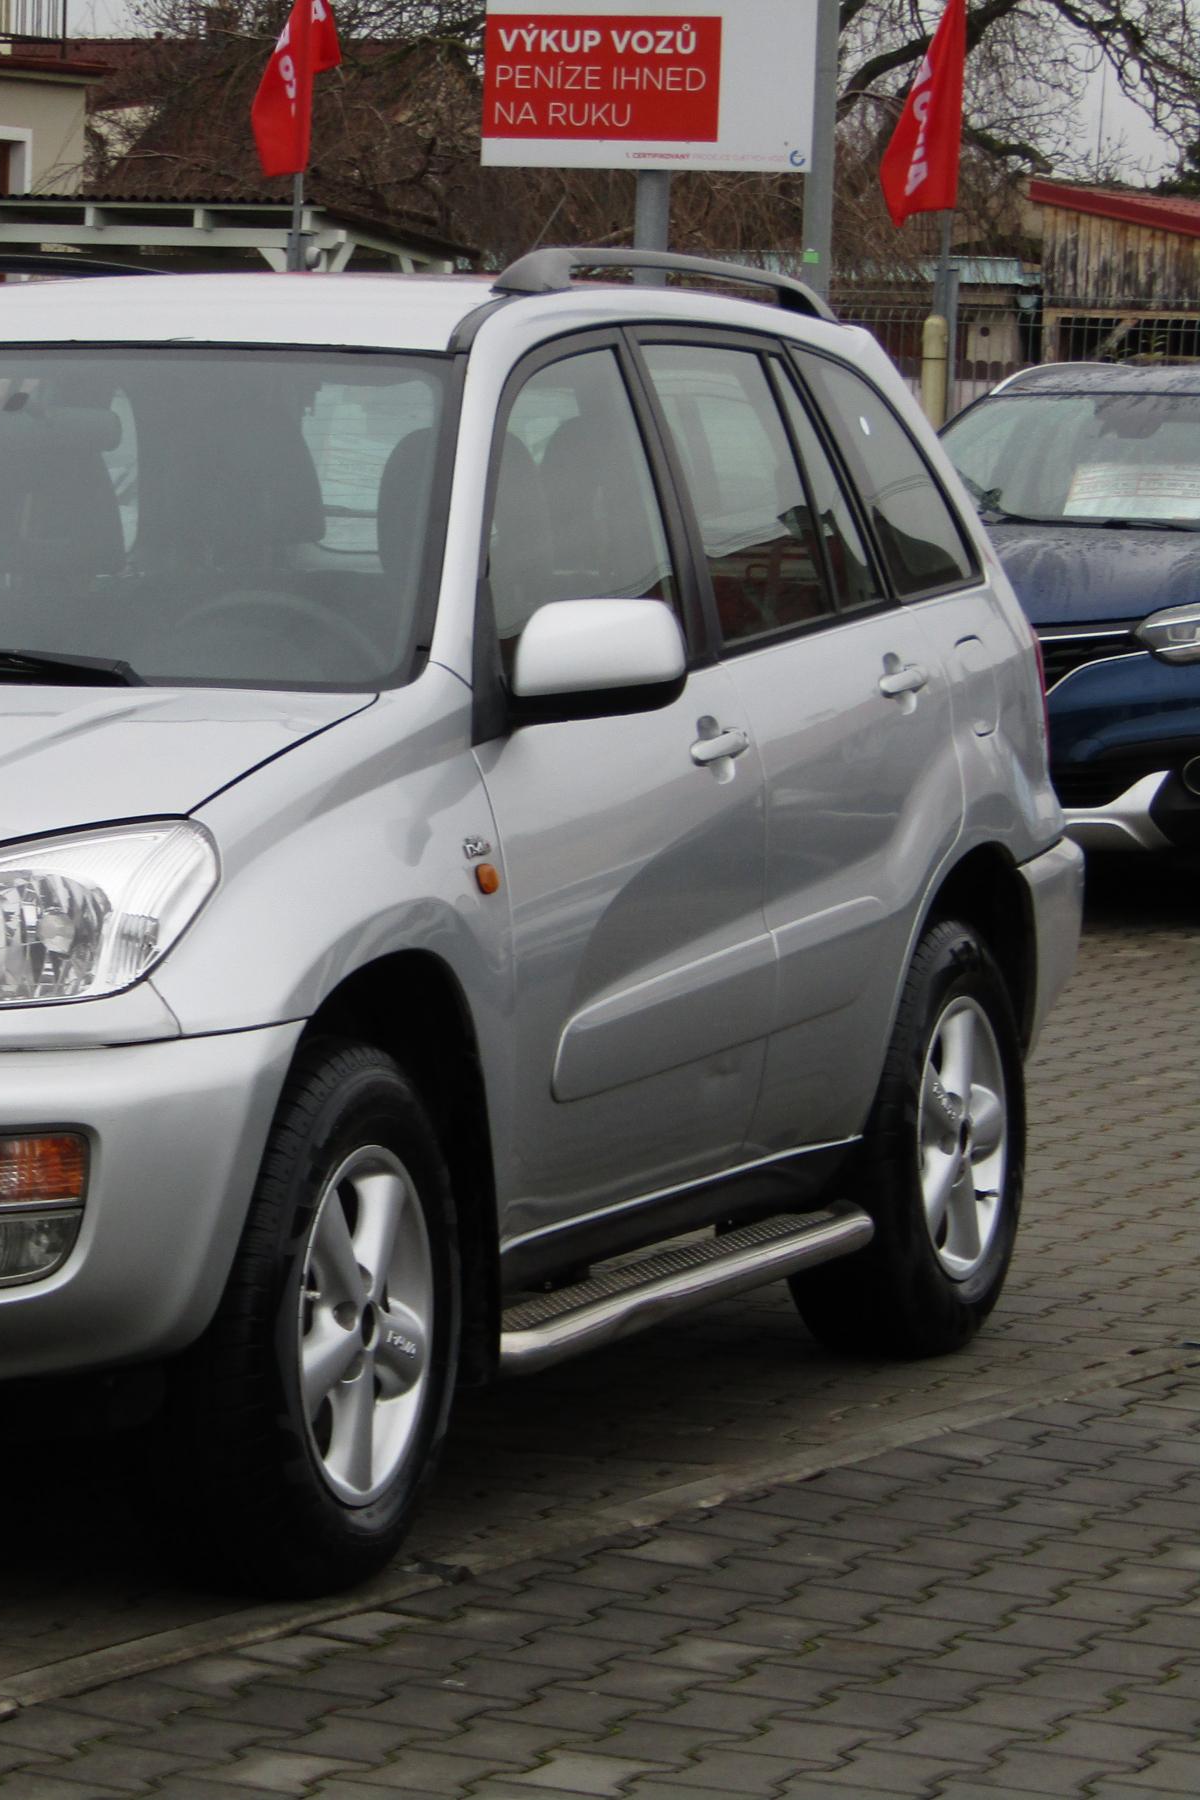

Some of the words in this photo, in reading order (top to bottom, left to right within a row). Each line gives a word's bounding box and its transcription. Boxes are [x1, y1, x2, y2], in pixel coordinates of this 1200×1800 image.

[498, 23, 601, 53] VÝKUP
[610, 23, 697, 54] VOZŮ
[496, 61, 602, 90] PENÍZE
[612, 67, 706, 92] IHNED
[494, 102, 538, 126] NA
[548, 102, 632, 127] RUKU
